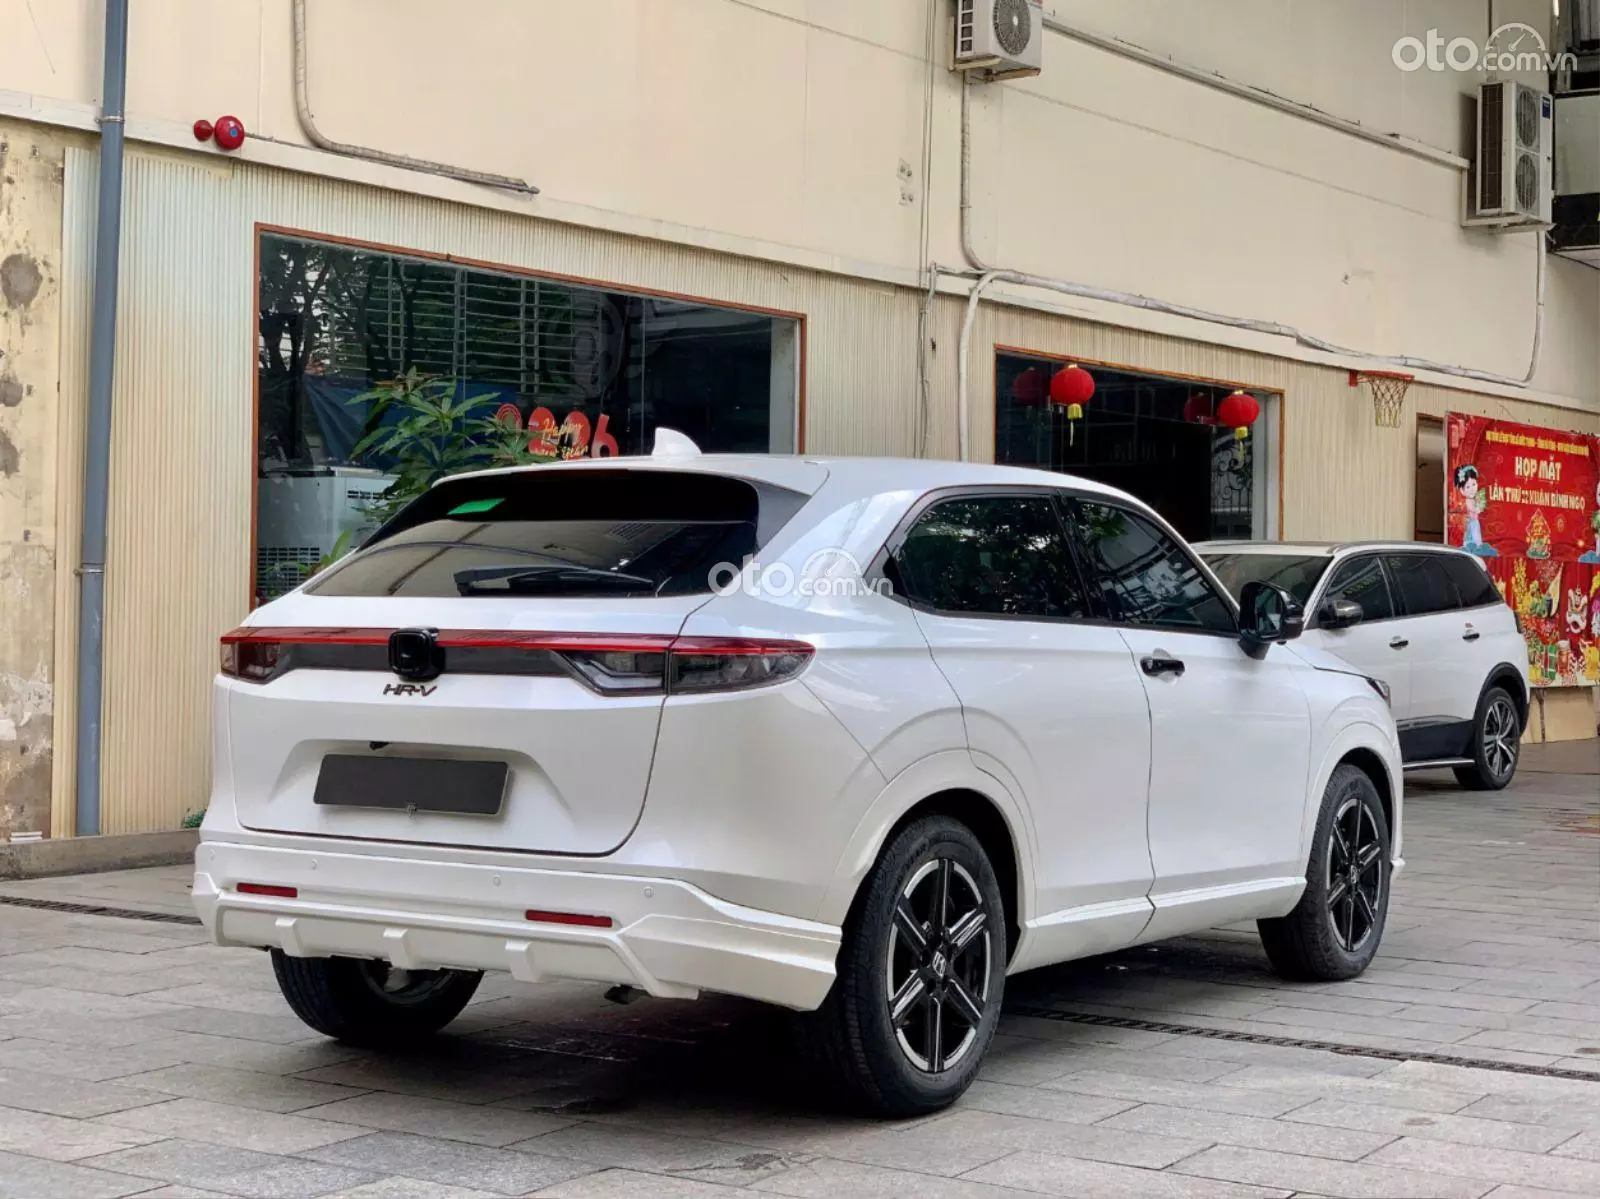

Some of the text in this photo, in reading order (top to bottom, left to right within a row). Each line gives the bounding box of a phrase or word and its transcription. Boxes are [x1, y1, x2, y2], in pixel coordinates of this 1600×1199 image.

[1515, 454, 1561, 484] HỌP MẶT
[383, 683, 438, 697] HR-V
